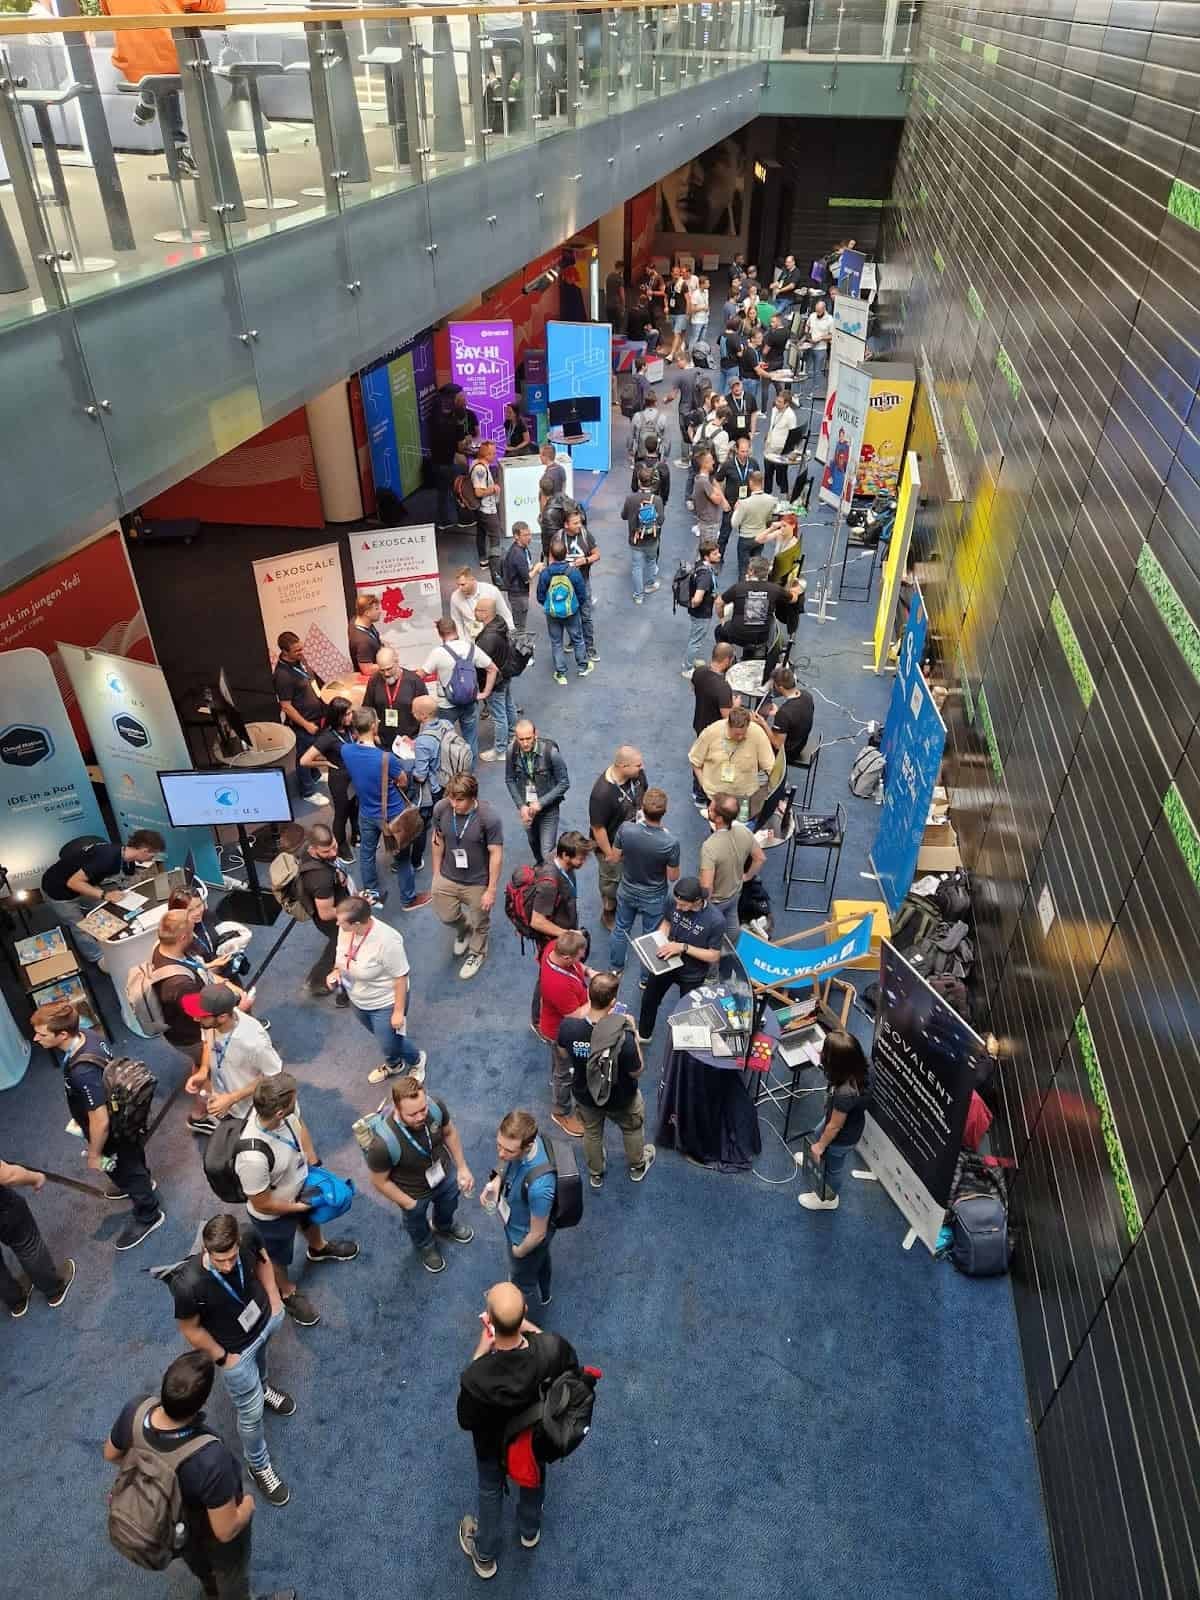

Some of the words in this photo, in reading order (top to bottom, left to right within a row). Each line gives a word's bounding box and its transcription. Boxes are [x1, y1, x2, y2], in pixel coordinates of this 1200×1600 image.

[455, 346, 481, 360] SAY
[484, 346, 499, 359] HI
[456, 363, 475, 376] TO
[478, 361, 500, 375] A.I.
[837, 407, 860, 429] WOLKE
[372, 535, 426, 549] EXOSCALE
[274, 558, 335, 579] EXOSCALE
[30, 588, 62, 617] jungen
[7, 794, 29, 807] IDE
[53, 783, 75, 794] Pod
[879, 1015, 953, 1105] ISOVALENT
